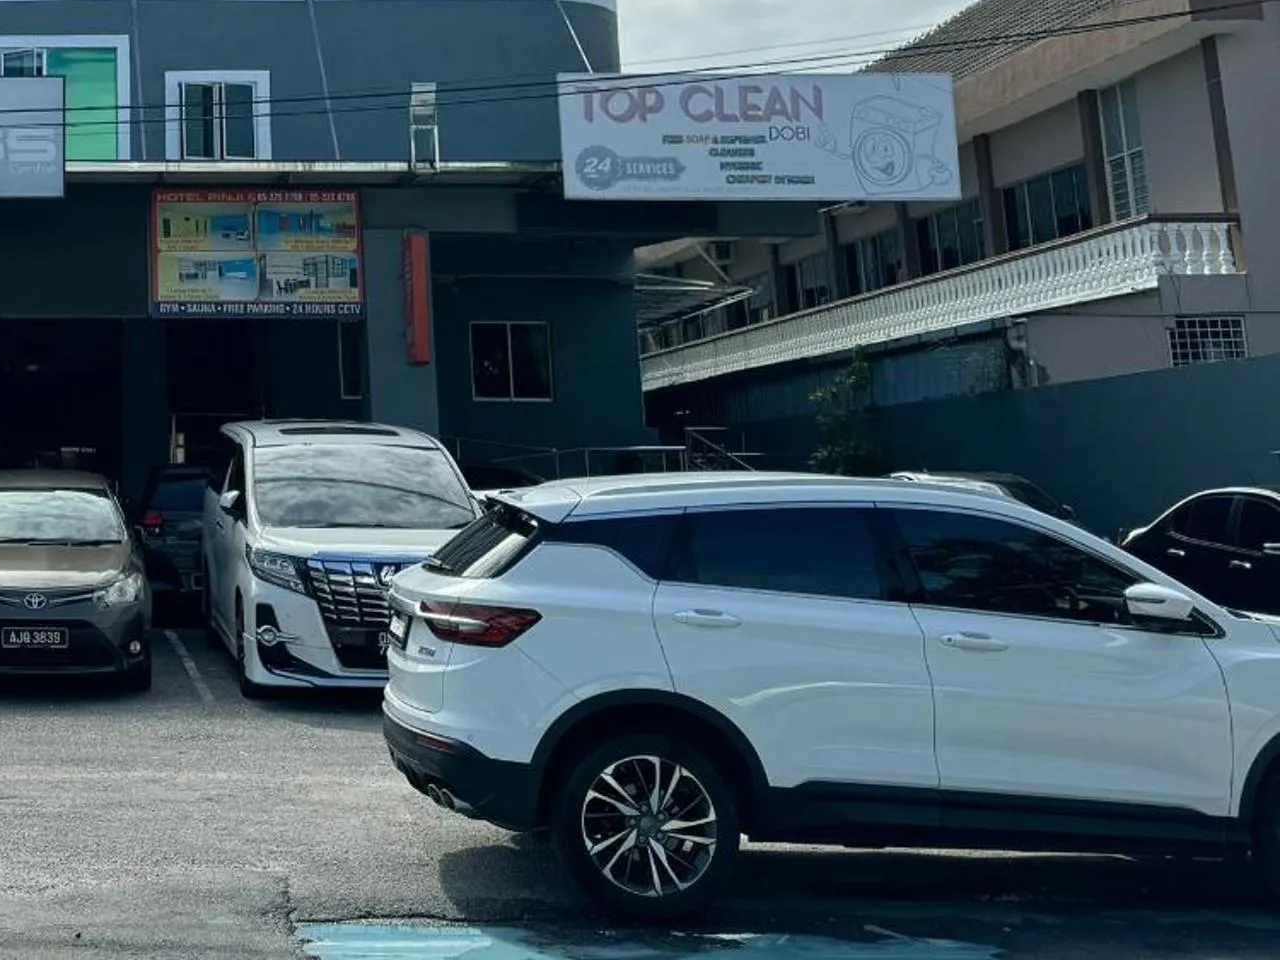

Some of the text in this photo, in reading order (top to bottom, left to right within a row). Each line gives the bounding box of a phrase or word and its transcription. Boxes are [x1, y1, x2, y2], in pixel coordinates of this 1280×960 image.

[573, 84, 824, 124] TOP CLEAN
[769, 126, 810, 141] DOBI
[583, 157, 675, 175] 24 SERVICES
[156, 192, 203, 203] HOTEL
[337, 303, 361, 315] CCTV
